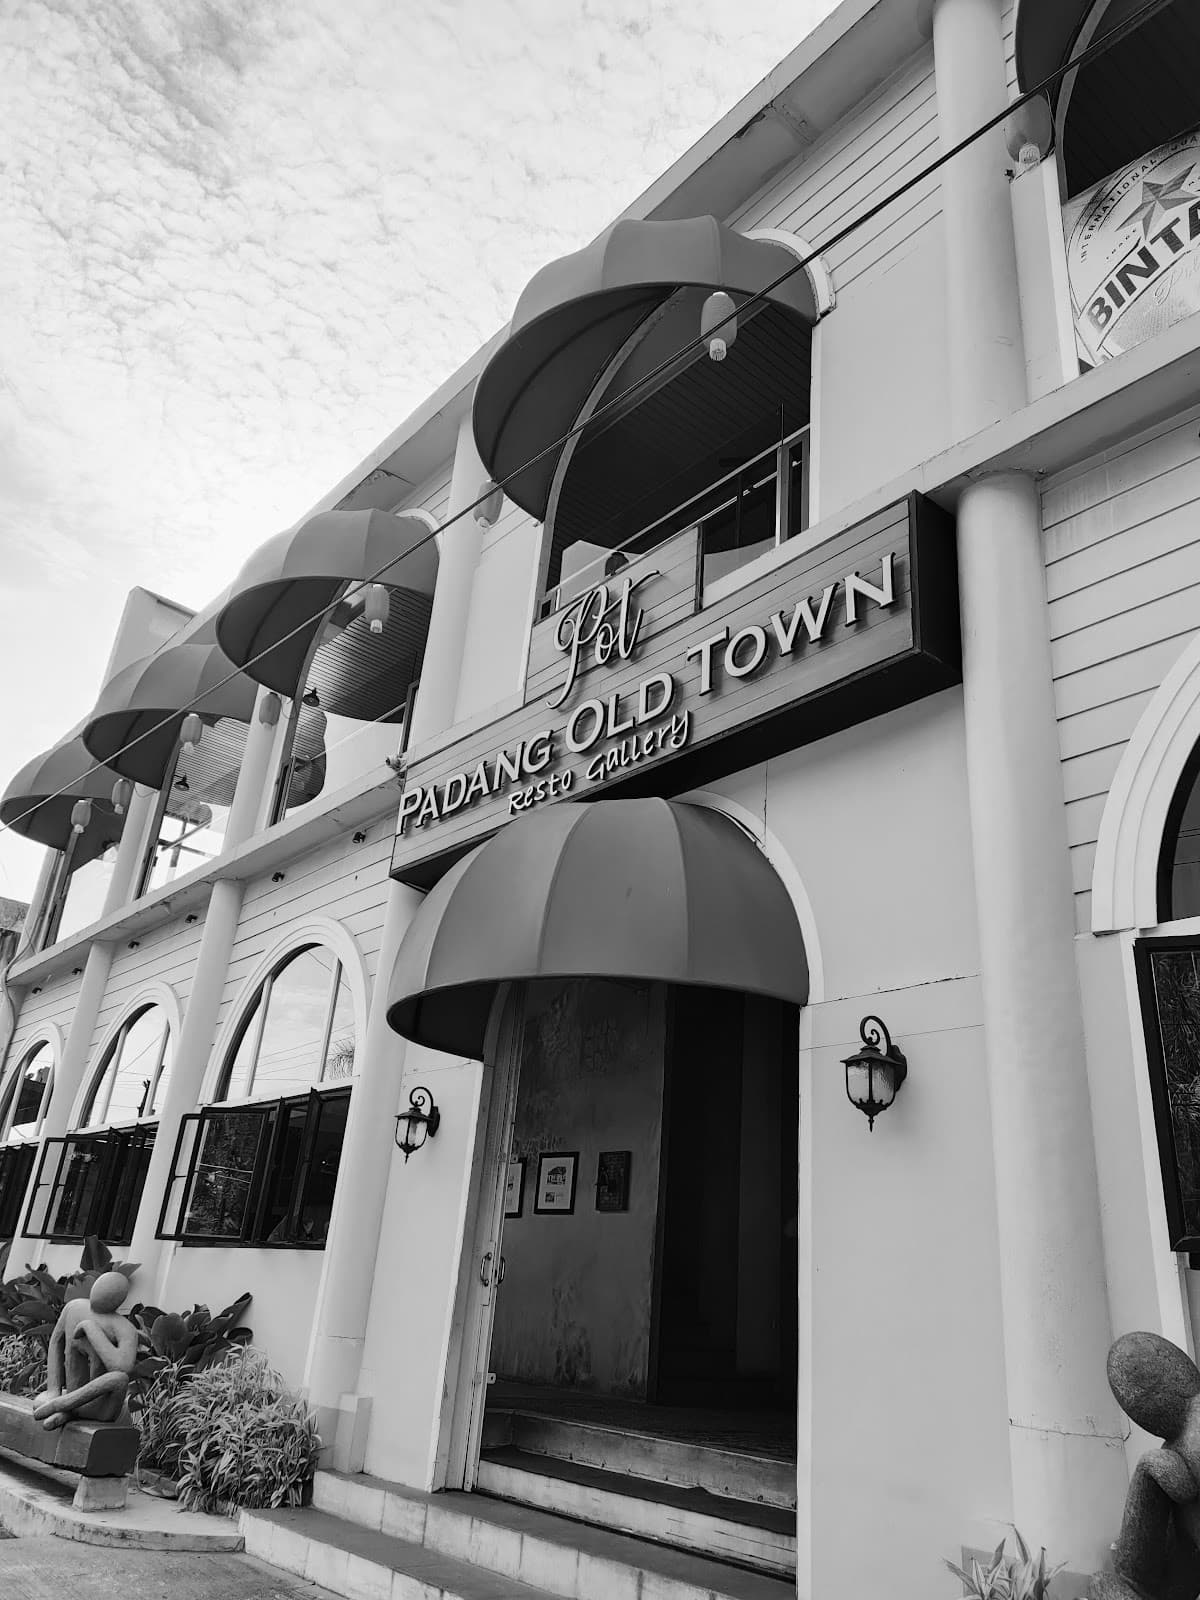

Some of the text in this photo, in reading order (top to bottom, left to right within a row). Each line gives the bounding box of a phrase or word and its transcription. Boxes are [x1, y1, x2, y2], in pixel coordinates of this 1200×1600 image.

[395, 552, 896, 837] PADANG OLD TOWN
[586, 709, 690, 781] Gallery
